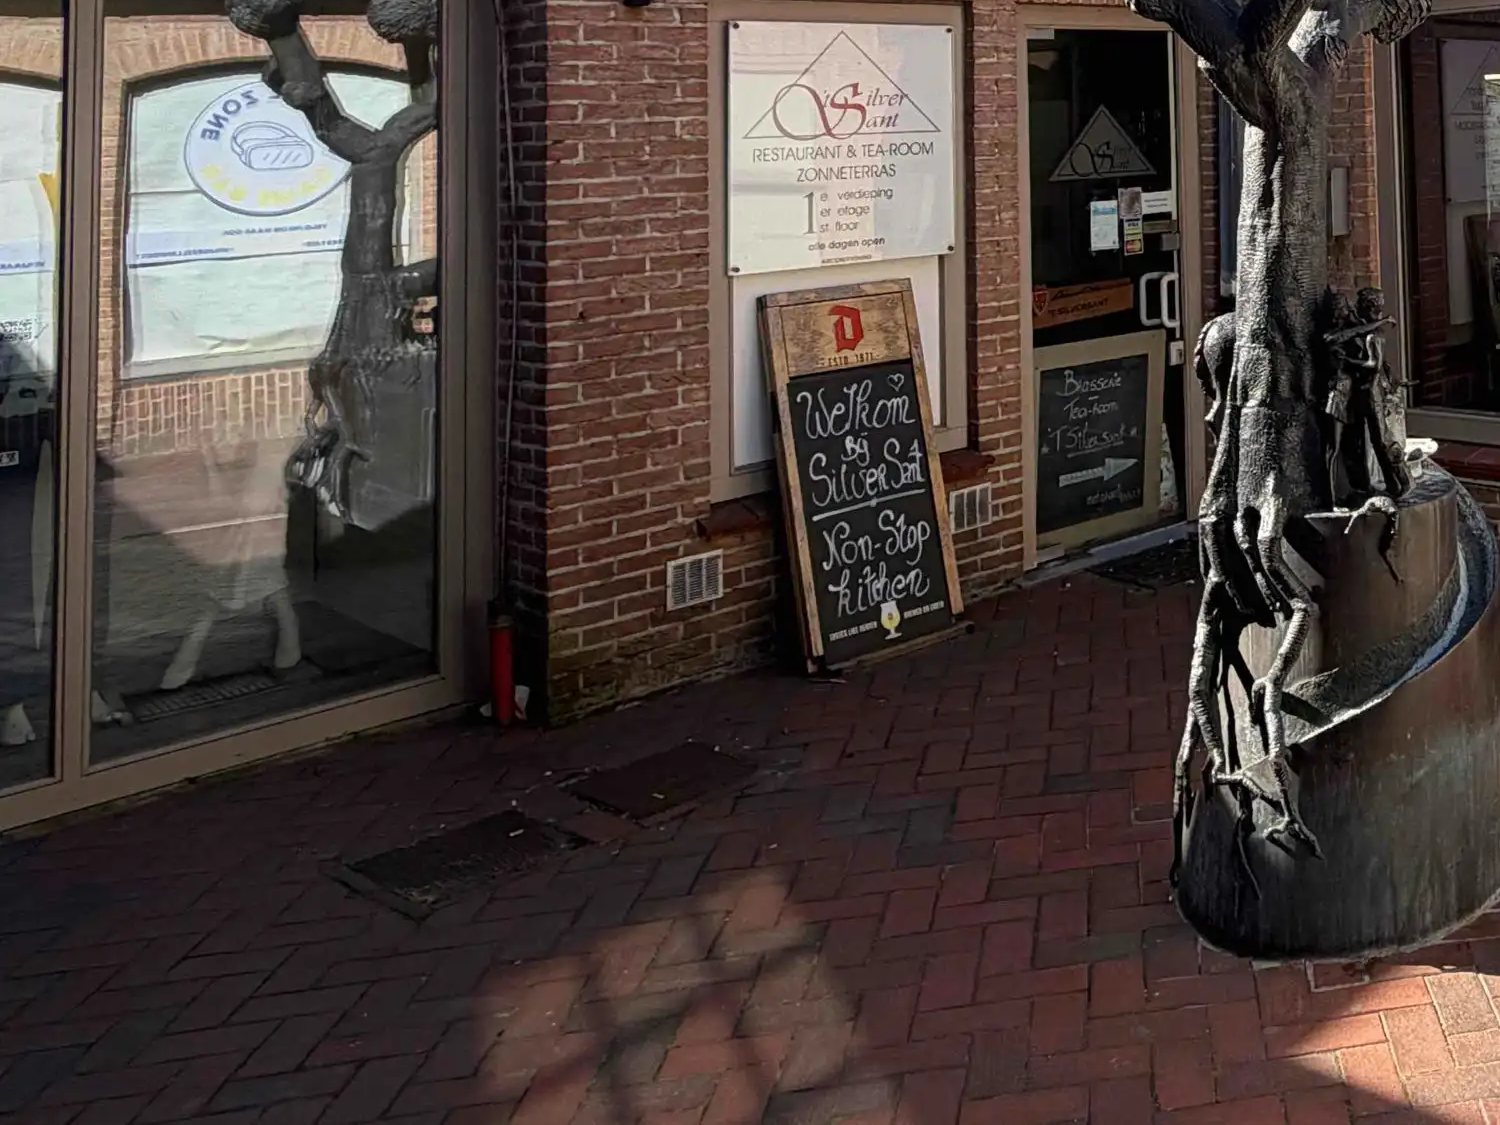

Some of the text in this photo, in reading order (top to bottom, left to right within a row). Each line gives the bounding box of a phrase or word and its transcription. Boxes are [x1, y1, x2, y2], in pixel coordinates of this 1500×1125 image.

[752, 142, 934, 163] RESTAURANT & TEA-ROOM
[796, 164, 897, 183] ZONNETERRAS
[837, 188, 893, 201] verdieping
[802, 191, 817, 235] 1
[820, 205, 870, 218] er etage
[835, 220, 859, 231] floor
[828, 238, 859, 251] dagen
[861, 237, 886, 249] open
[797, 379, 915, 440] Welkom
[822, 509, 931, 572] Non-Stop
